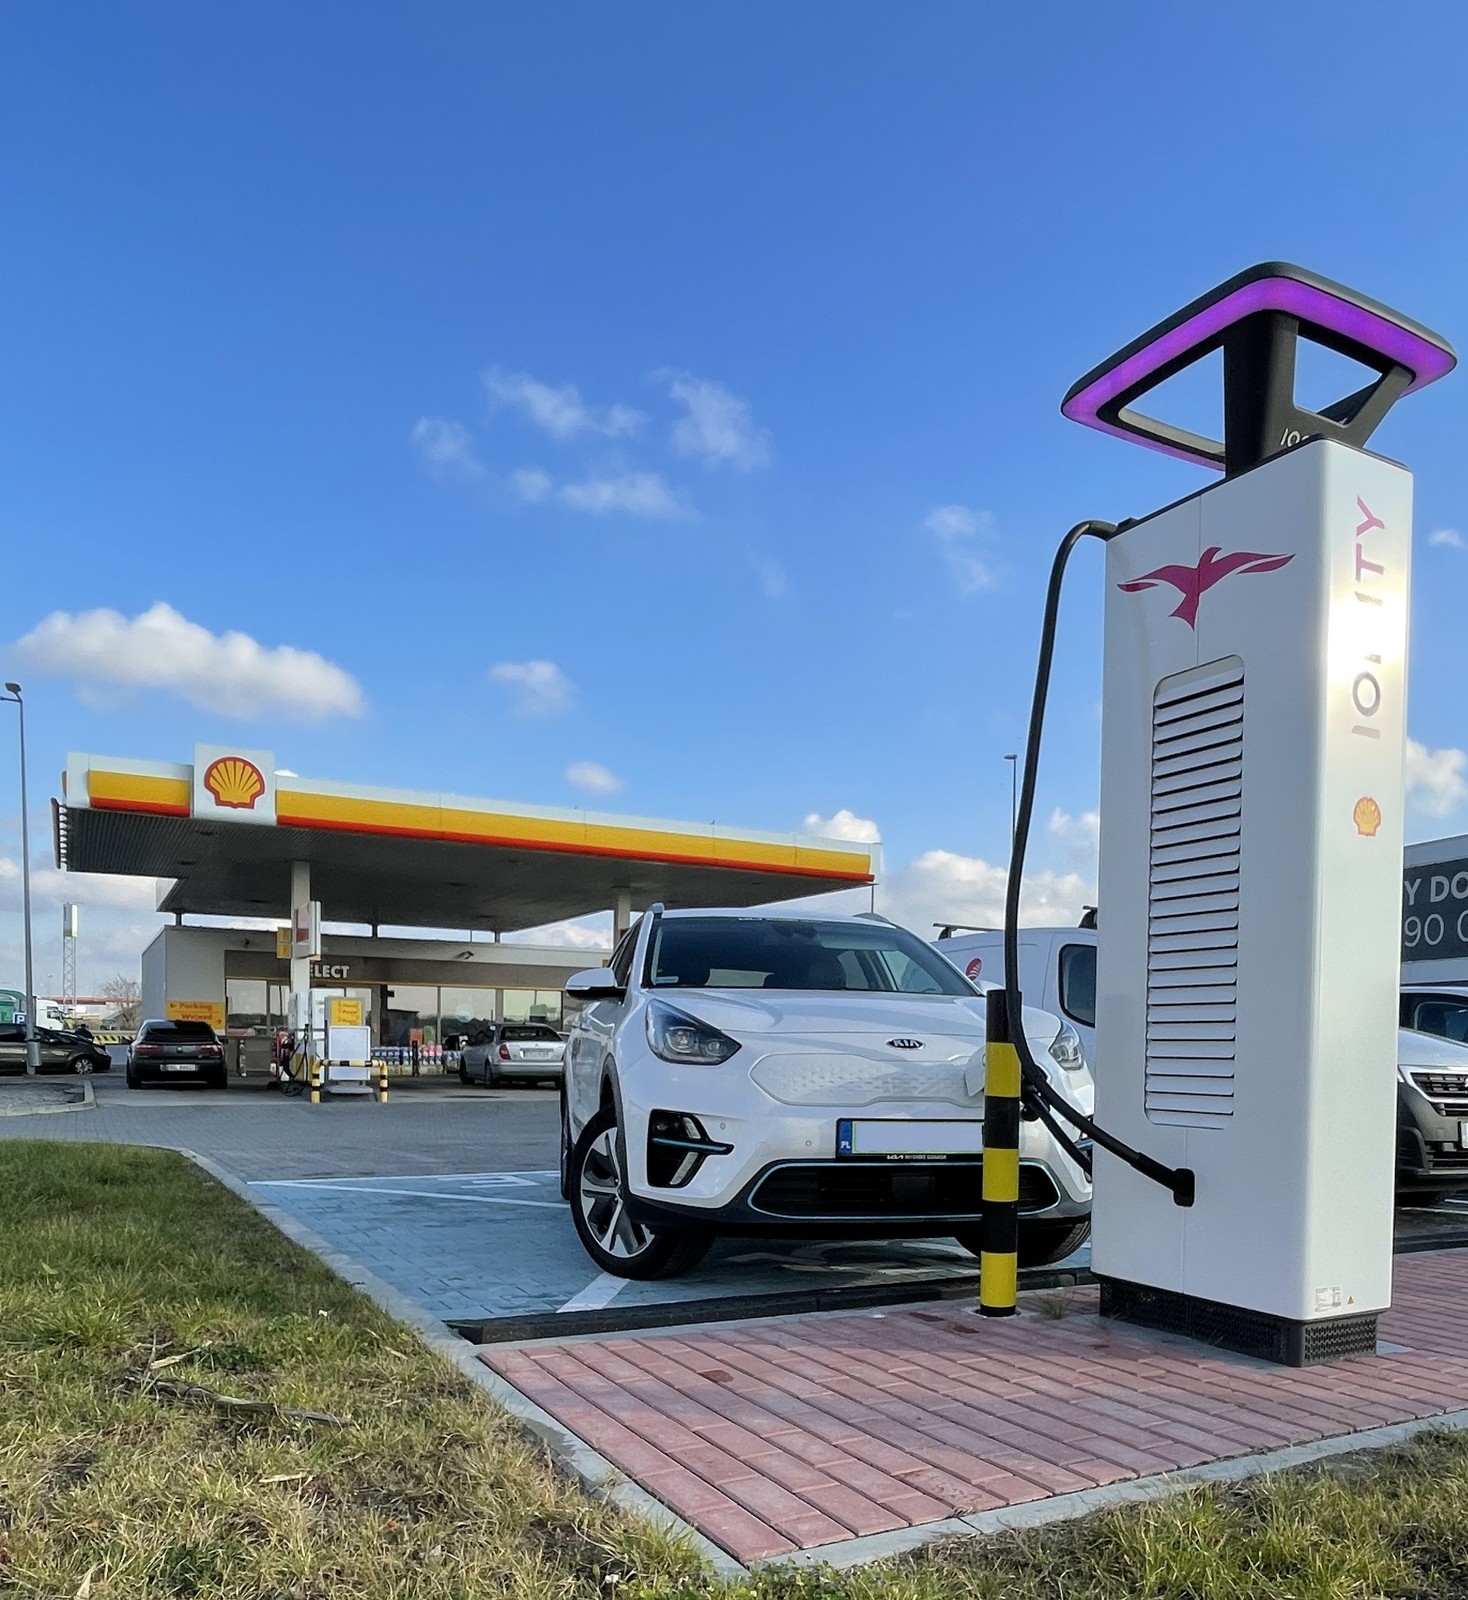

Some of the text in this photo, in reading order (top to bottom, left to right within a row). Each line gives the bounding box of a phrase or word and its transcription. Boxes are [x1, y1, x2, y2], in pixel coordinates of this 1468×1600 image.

[1351, 493, 1386, 740] IOITY
[1404, 913, 1444, 948] 90
[840, 1140, 851, 1149] PL
